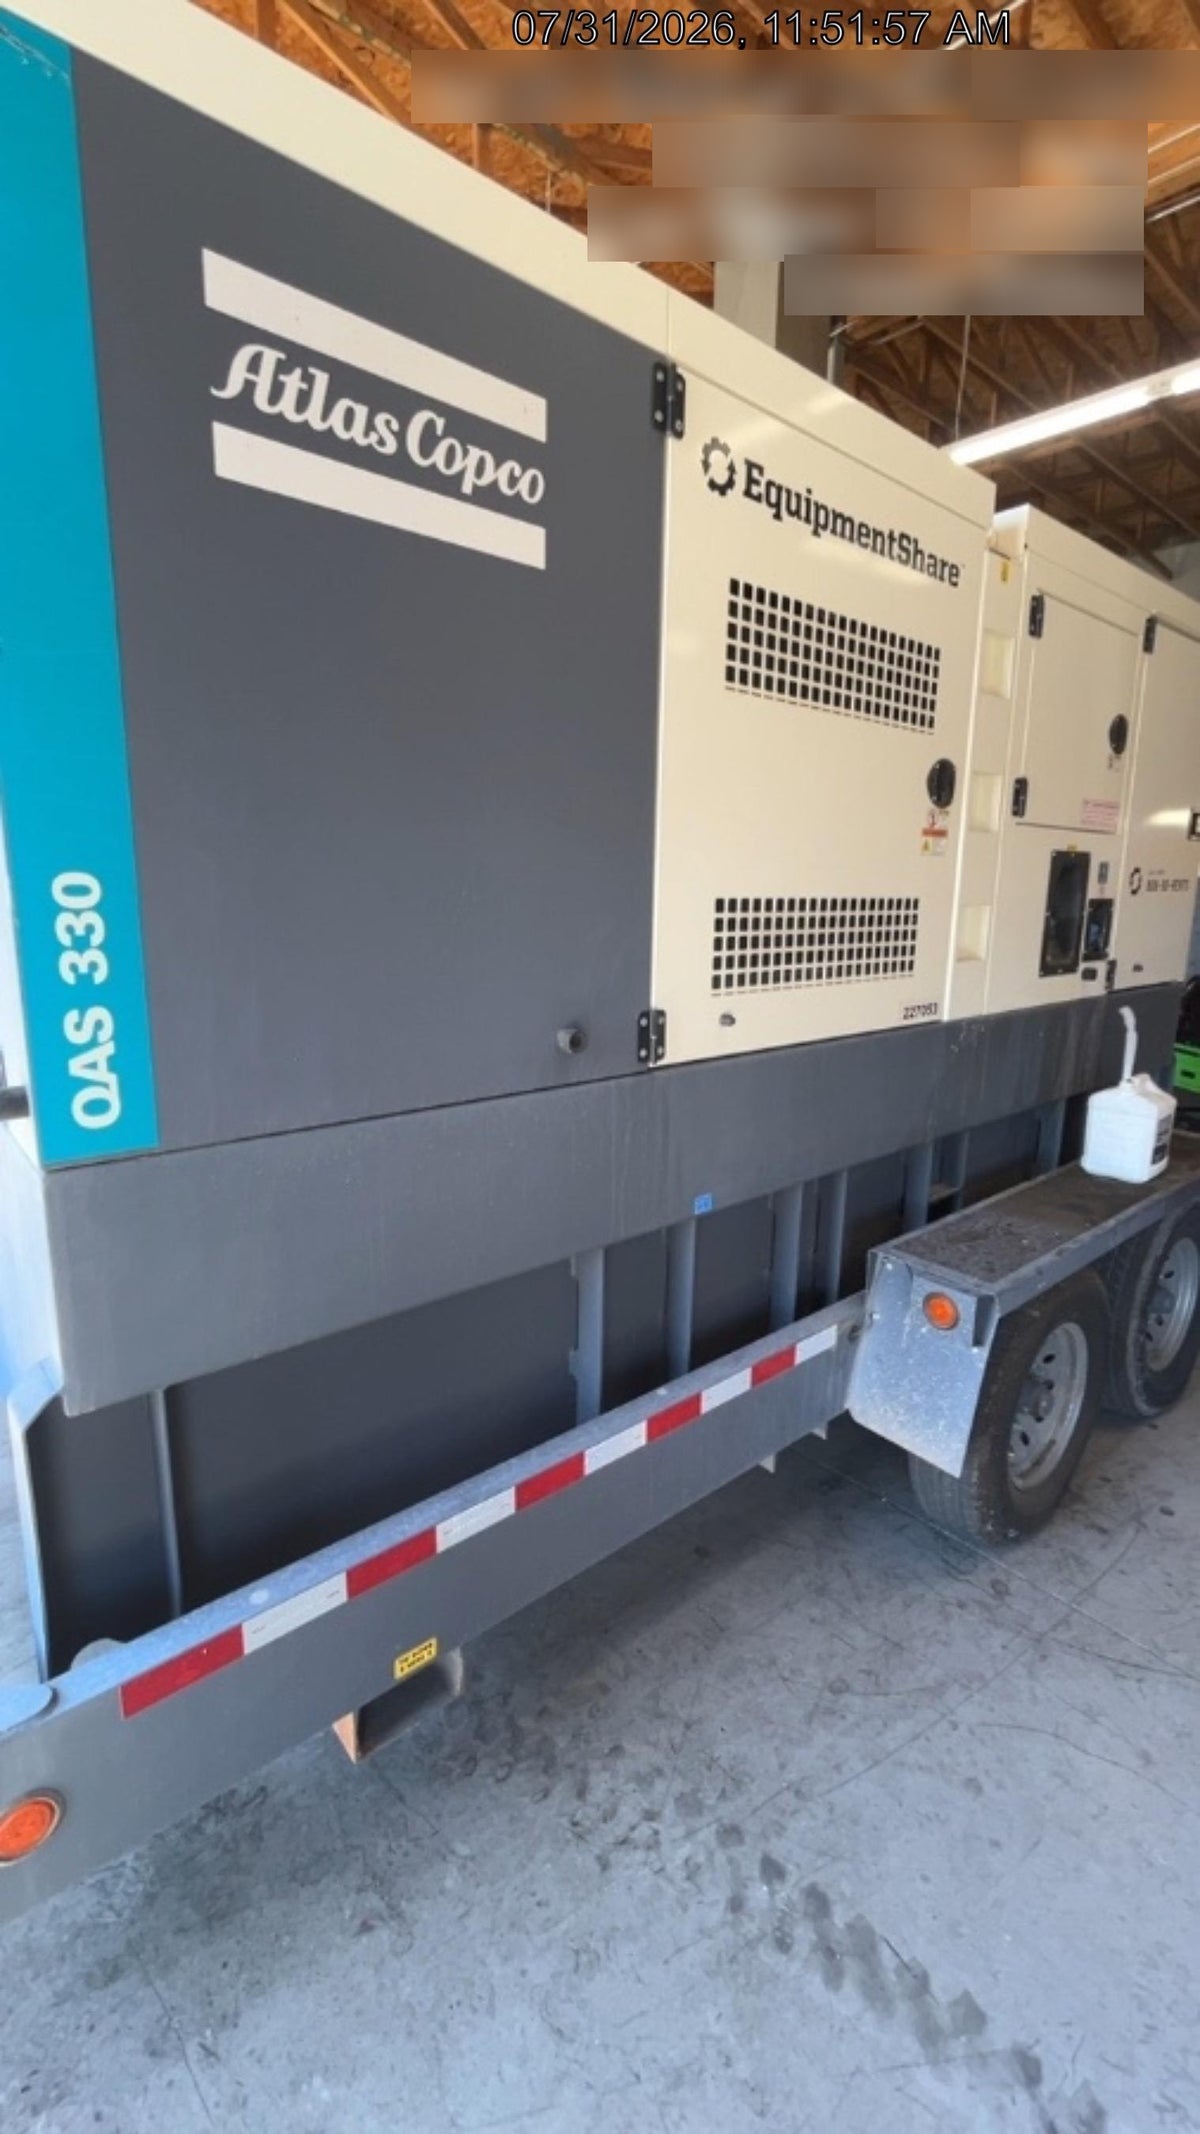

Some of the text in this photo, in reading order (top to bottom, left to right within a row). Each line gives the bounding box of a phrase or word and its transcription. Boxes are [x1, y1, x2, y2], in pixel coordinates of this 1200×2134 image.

[209, 343, 546, 505] Atlas Copco
[742, 458, 961, 588] EquipmentShare
[51, 870, 122, 1130] QAS 330
